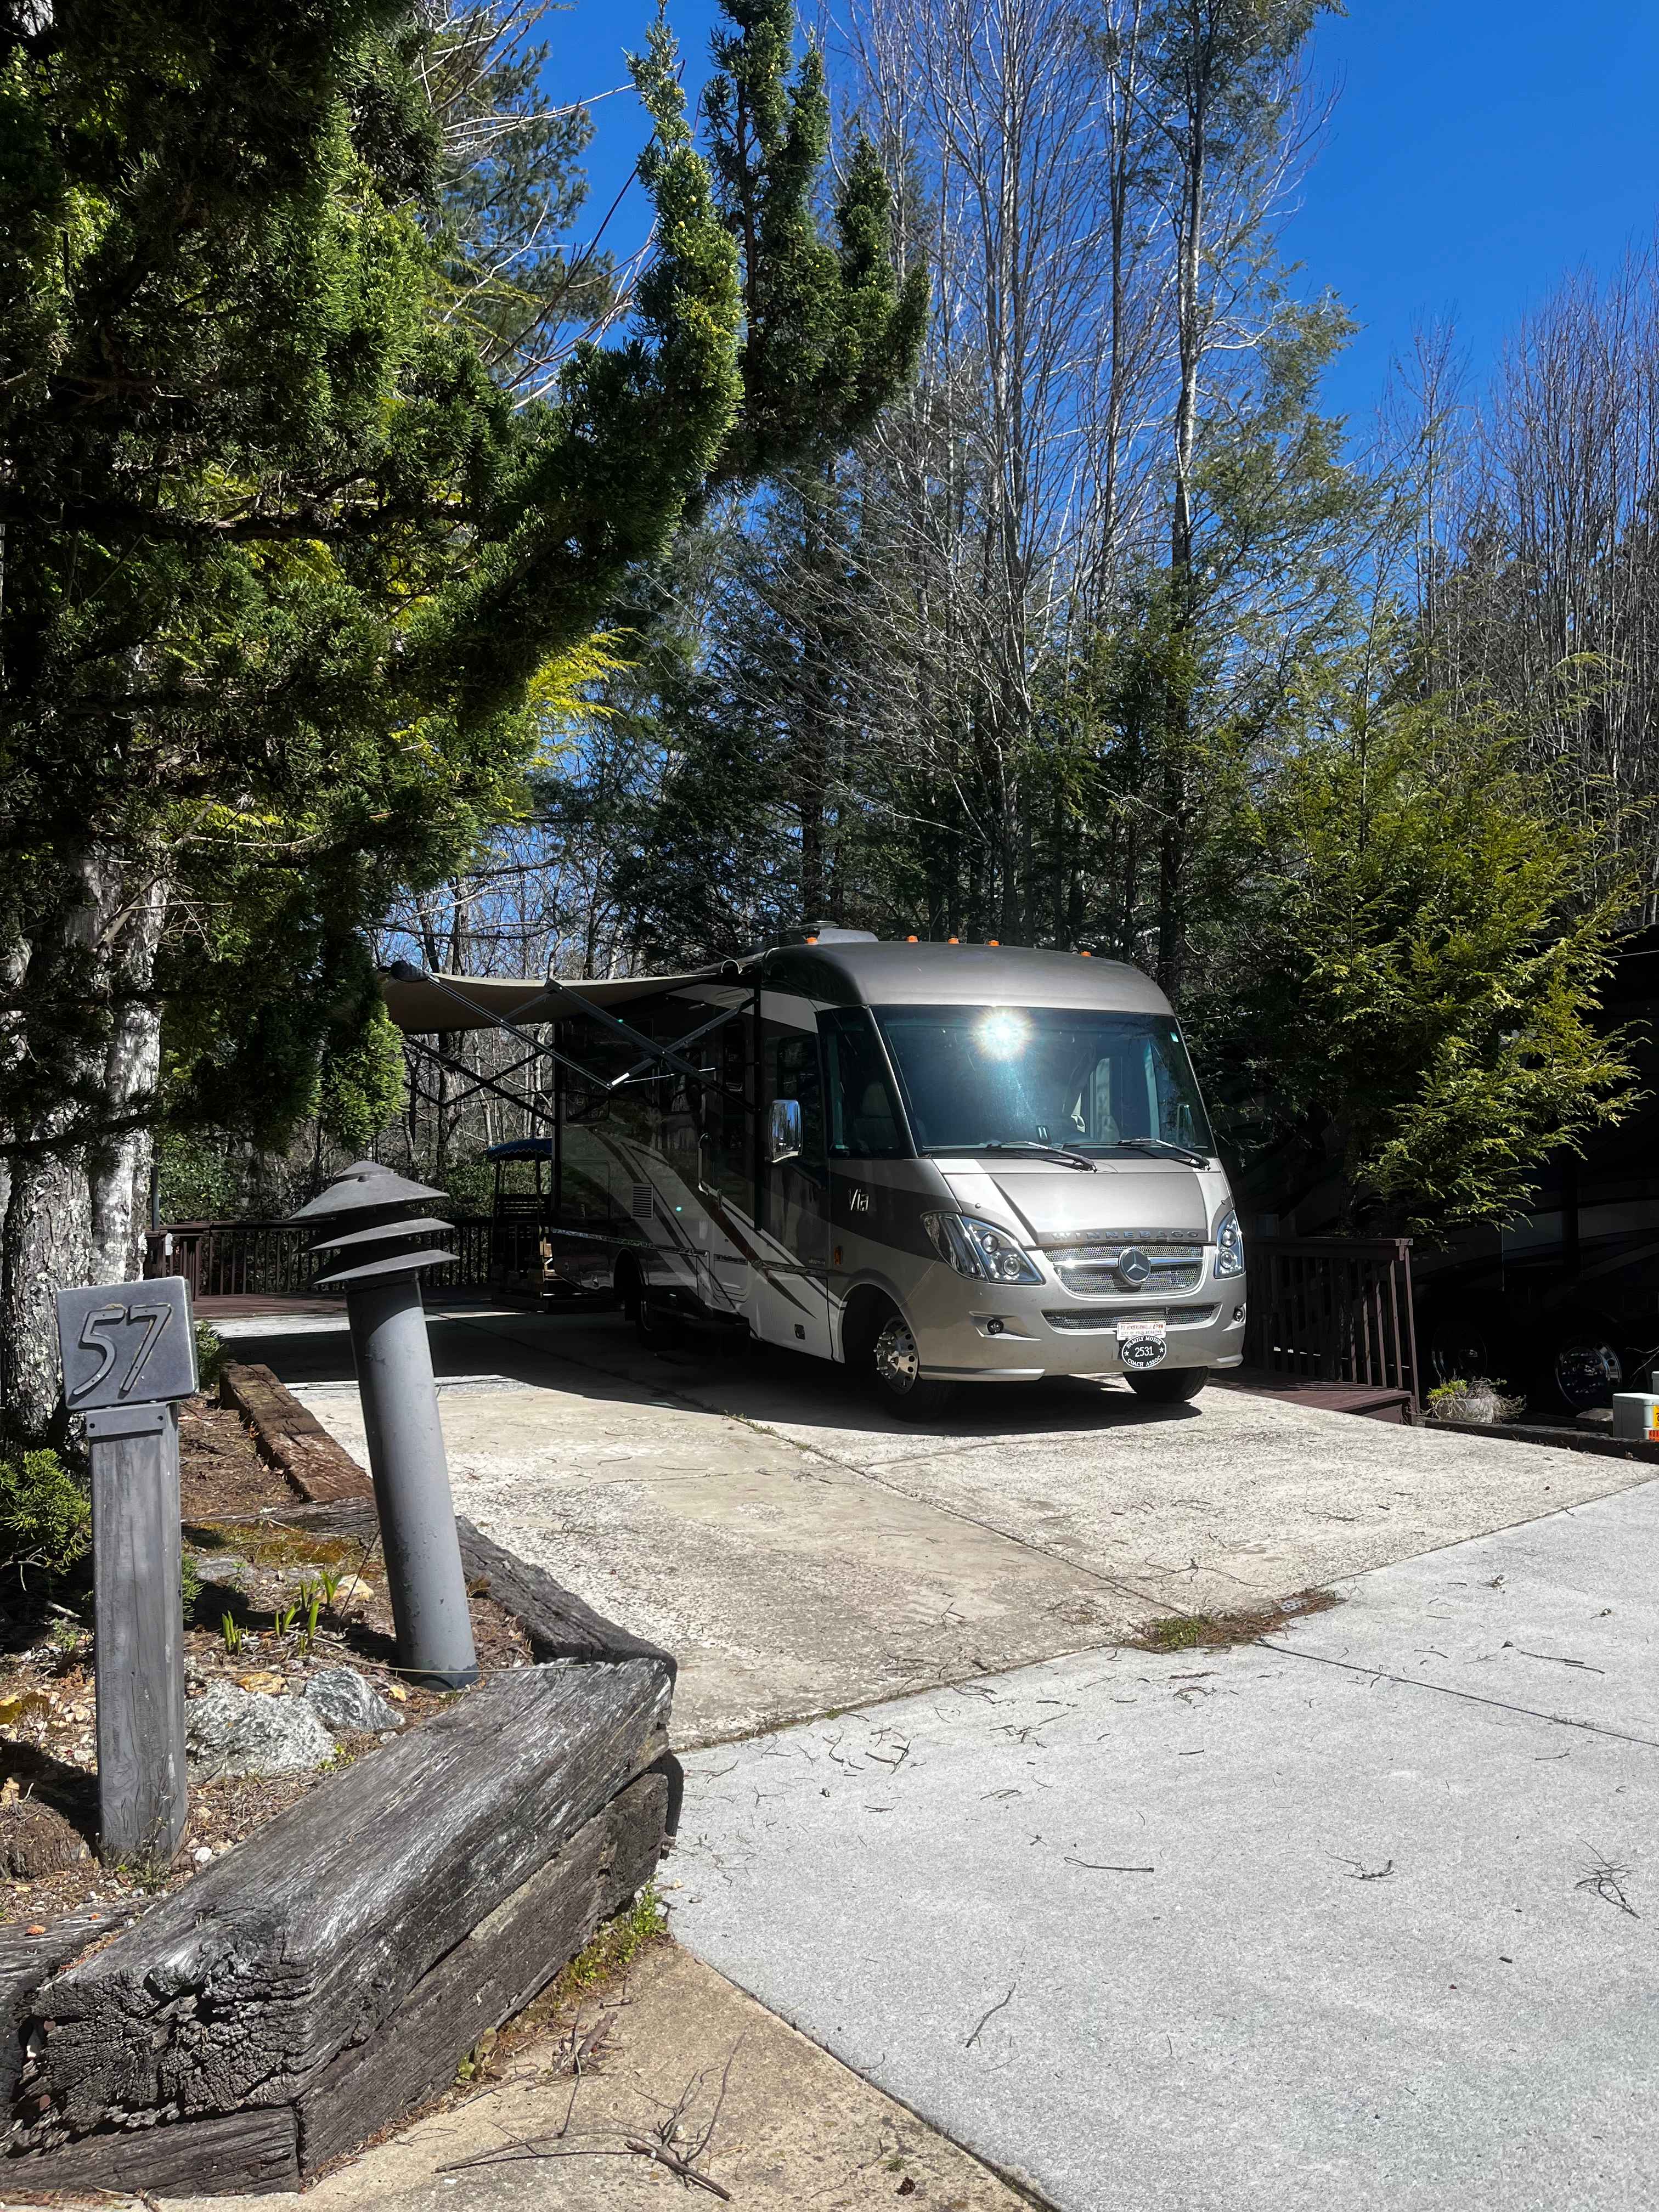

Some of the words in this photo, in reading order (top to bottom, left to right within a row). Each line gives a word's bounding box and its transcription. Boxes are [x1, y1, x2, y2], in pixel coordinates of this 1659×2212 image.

[848, 1188, 869, 1211] Via
[1052, 1230, 1198, 1242] WINNEBAGO
[1126, 1336, 1144, 1349] FAMILY
[1145, 1336, 1162, 1346] MOTOR
[72, 1304, 172, 1395] 57
[1135, 1346, 1154, 1357] 2531
[1127, 1358, 1144, 1367] COACH
